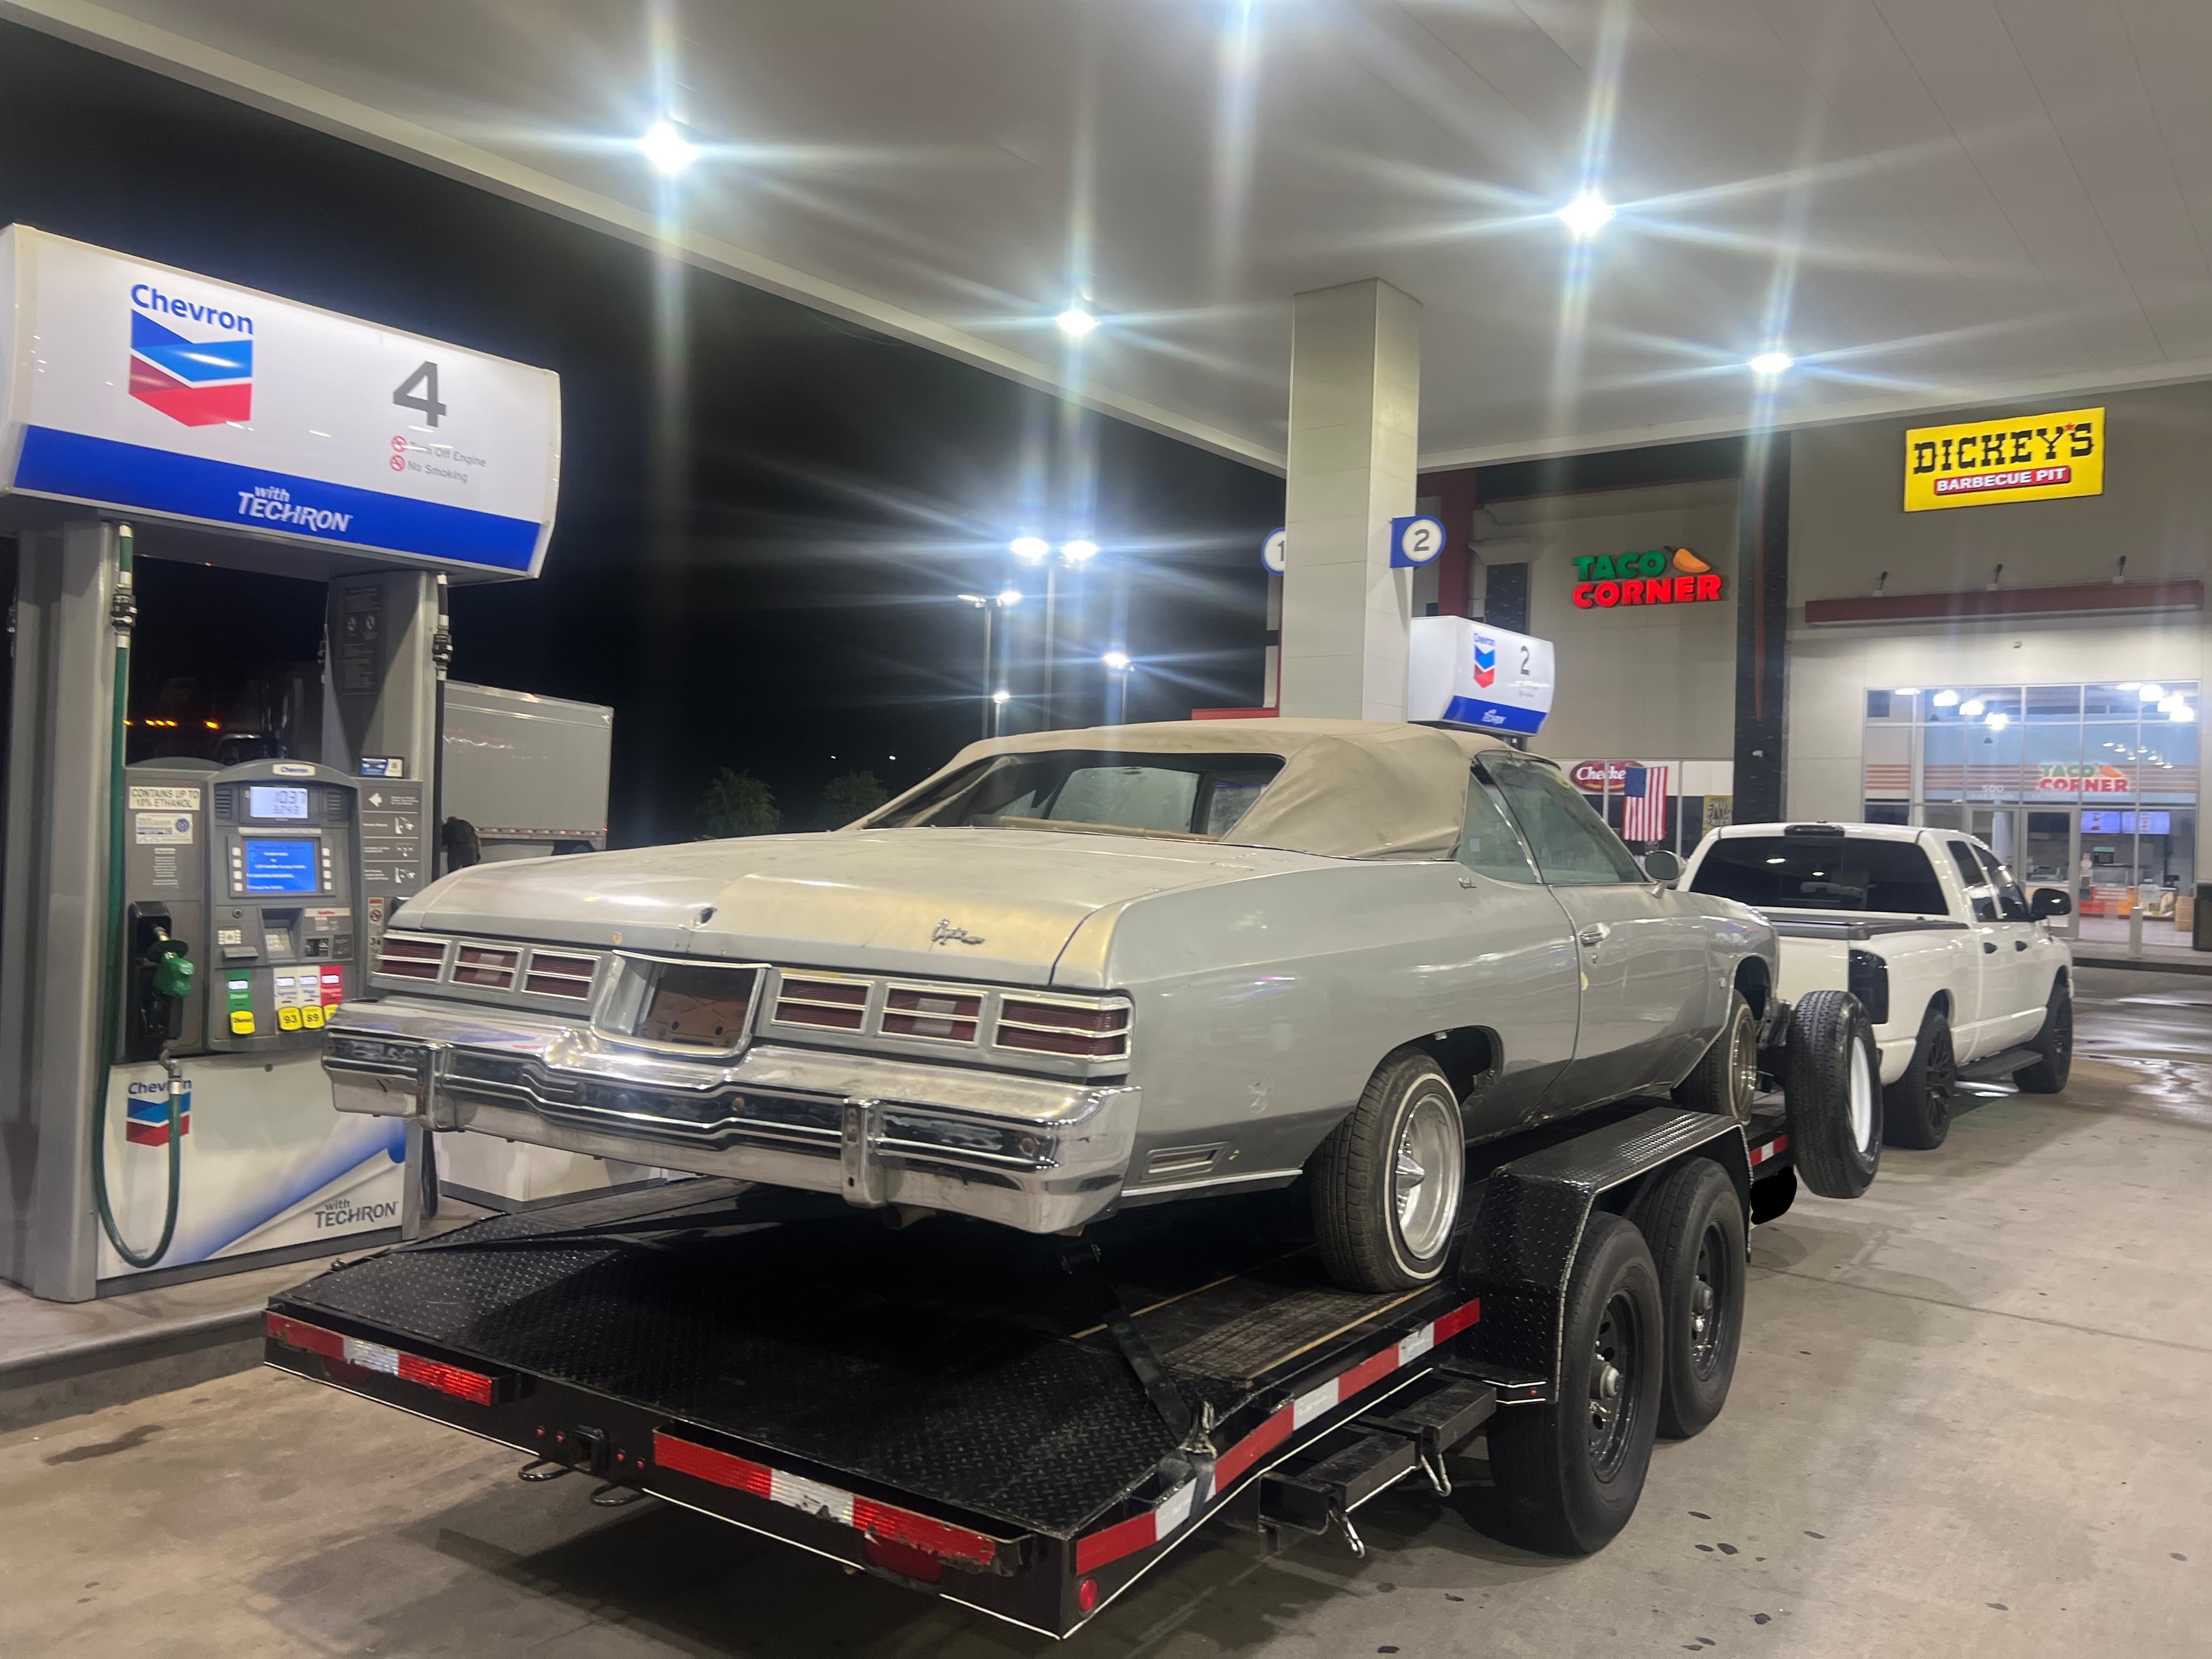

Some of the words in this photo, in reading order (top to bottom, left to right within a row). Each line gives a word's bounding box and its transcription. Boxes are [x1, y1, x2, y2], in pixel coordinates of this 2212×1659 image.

[131, 283, 253, 335] Chevron
[393, 361, 446, 428] 4
[453, 451, 486, 467] Engine
[1914, 422, 2094, 474] DICKEY'S
[408, 460, 422, 472] No
[425, 464, 469, 484] Smoking
[1937, 471, 2032, 491] BARBECUE
[2037, 467, 2067, 482] PIT
[255, 486, 290, 502] with
[238, 491, 352, 532] TECHRON
[1277, 540, 1285, 562] 1
[1413, 529, 1430, 551] 2
[1573, 550, 1666, 581] TACO
[1572, 574, 1722, 609] CORNER
[1521, 645, 1530, 675] 2
[2041, 764, 2094, 778] TACO
[132, 789, 173, 798] CONTAINS
[175, 790, 186, 798] UP
[188, 790, 199, 799] TO
[2040, 778, 2128, 791] CORNER
[154, 798, 193, 808] ETHANOL
[283, 1014, 297, 1024] 93
[128, 1080, 192, 1094] Chevn
[315, 1202, 397, 1228] TECHRON
[325, 1199, 350, 1210] with
